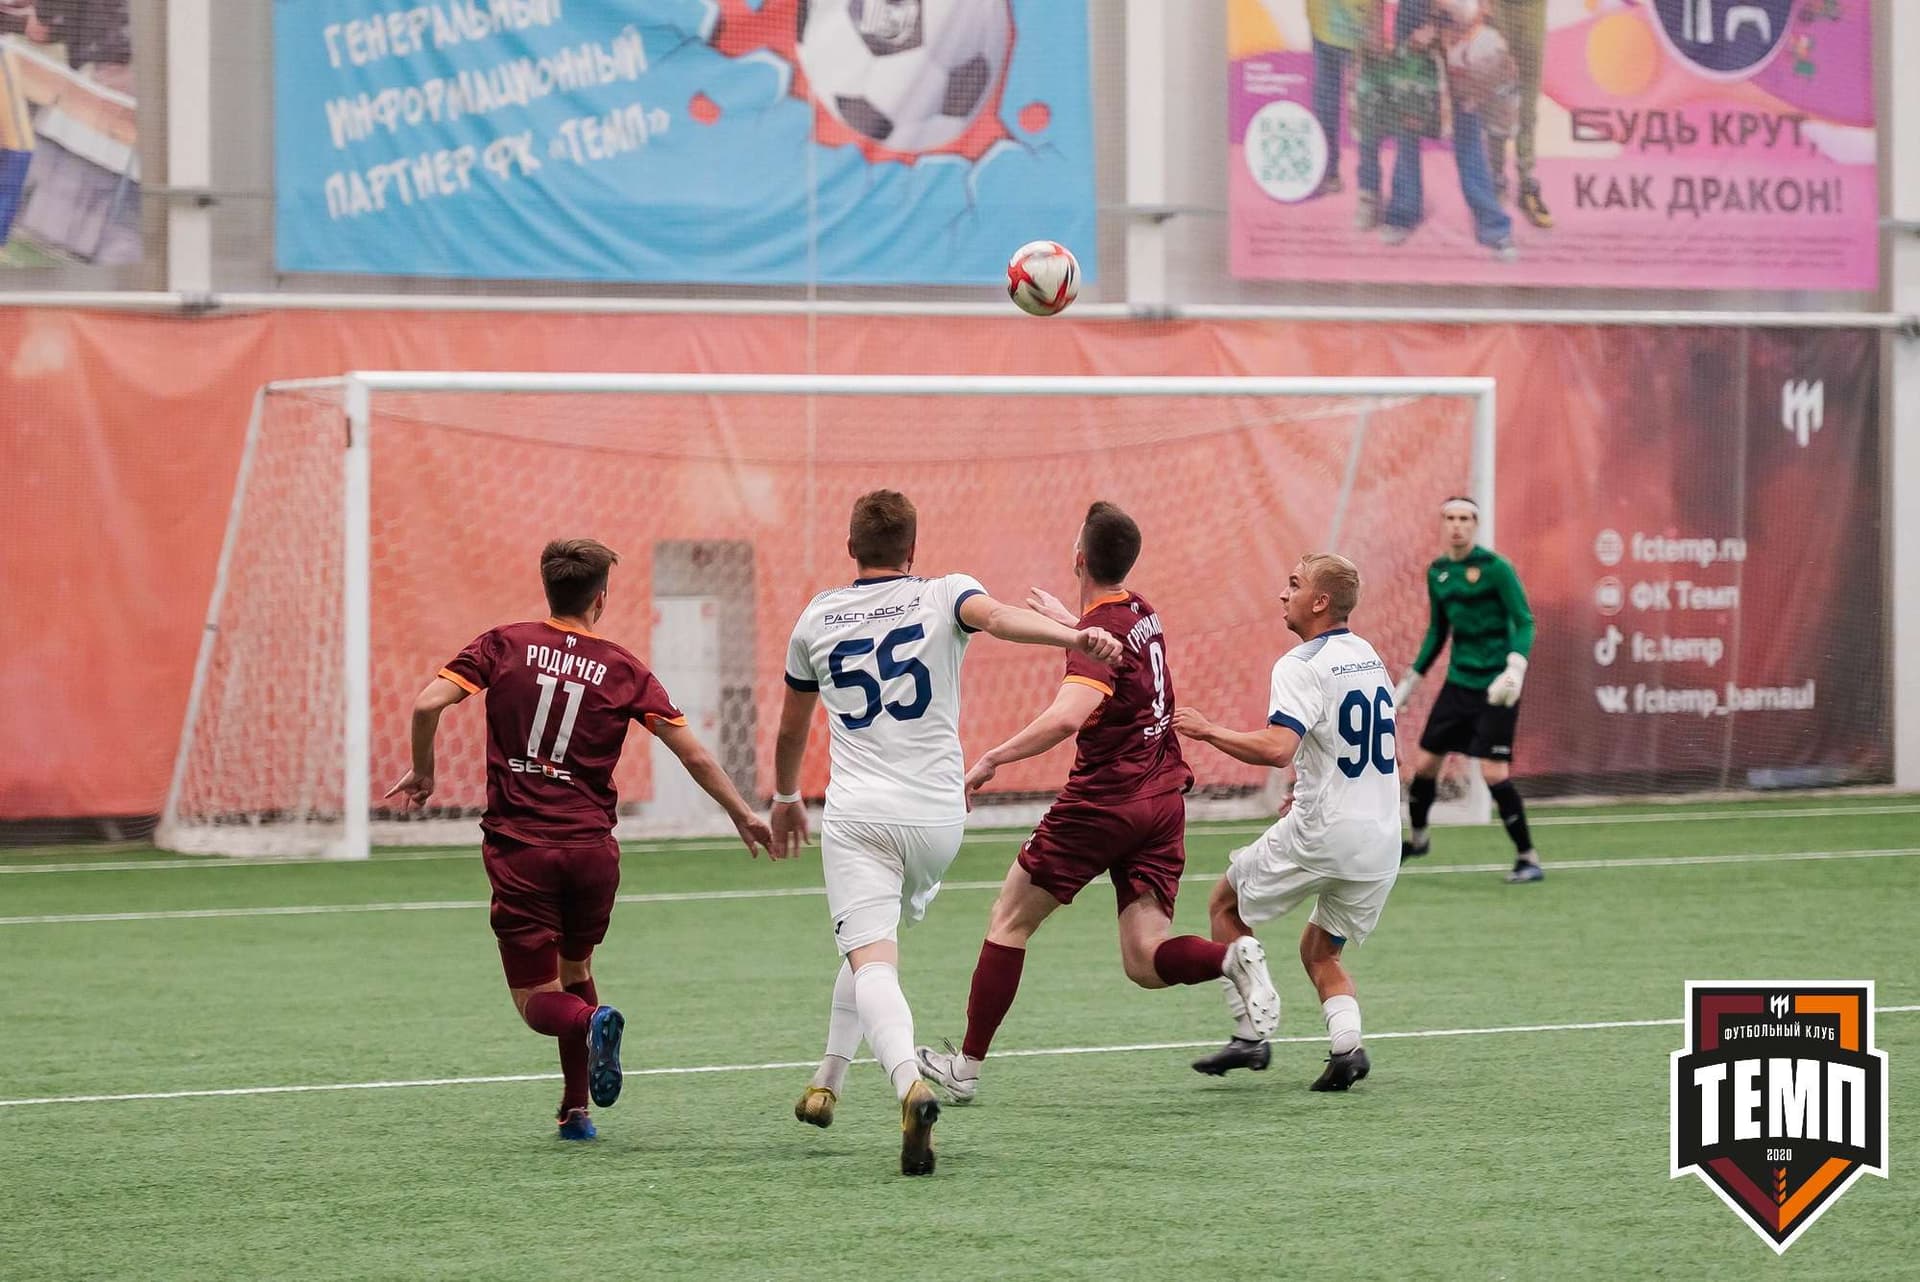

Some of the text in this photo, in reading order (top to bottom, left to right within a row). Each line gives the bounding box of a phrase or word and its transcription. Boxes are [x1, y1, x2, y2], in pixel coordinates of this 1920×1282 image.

[325, 24, 648, 149] ИНФОРМАЦИОННЫЙ
[1570, 108, 1818, 155] БУДЬ КРУТ,
[324, 144, 476, 221] ПАРТНЕР
[482, 129, 541, 181] ФК
[1574, 172, 1844, 220] КАК ДРАКОН!
[1632, 532, 1747, 568] fctemp.ru
[1631, 579, 1741, 612] ФК Темп
[526, 644, 608, 687] РОДИЧЕВ
[1631, 631, 1724, 668] fc.temp
[828, 622, 933, 731] 55
[1149, 641, 1165, 719] 9
[1633, 678, 1815, 718] fctemp_barnaul
[526, 672, 586, 764] 11
[1336, 685, 1396, 779] 96
